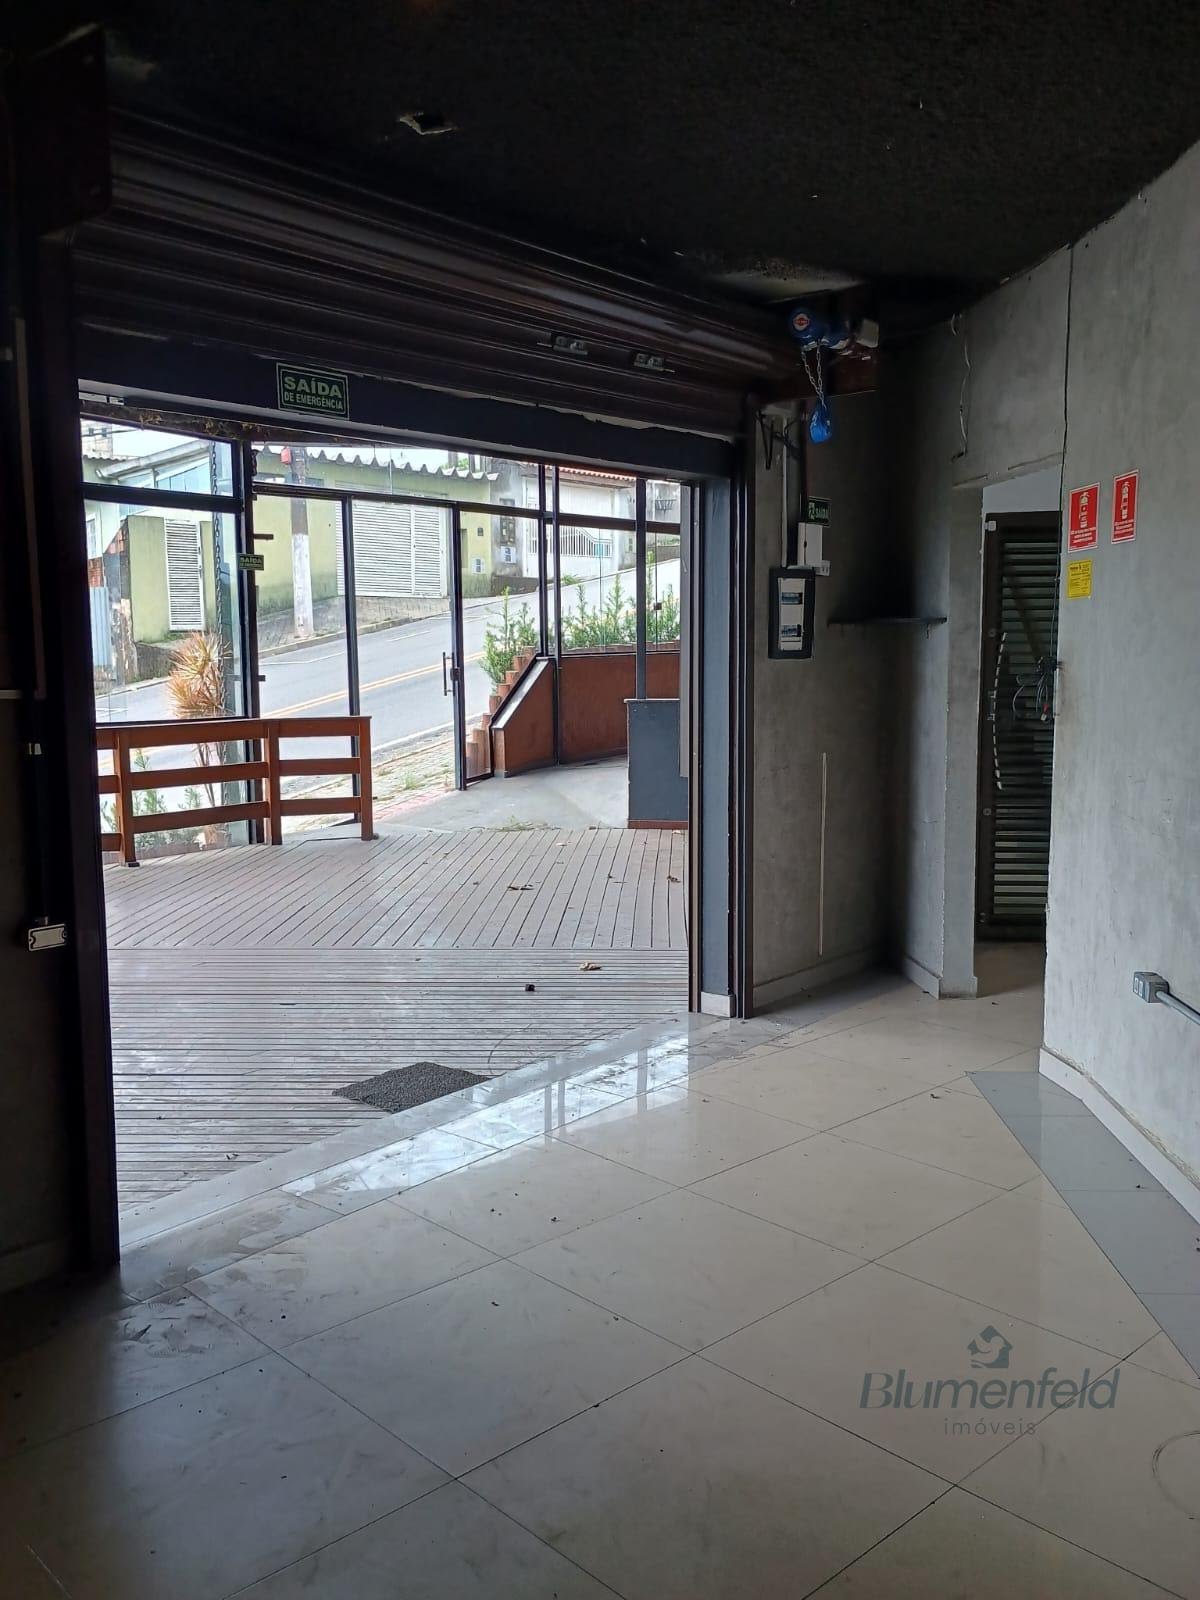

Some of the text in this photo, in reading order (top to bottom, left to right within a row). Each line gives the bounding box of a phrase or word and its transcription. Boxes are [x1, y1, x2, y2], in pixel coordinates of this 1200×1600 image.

[284, 376, 342, 399] SAÍDA
[284, 392, 343, 410] DE EMERGÊNCIA
